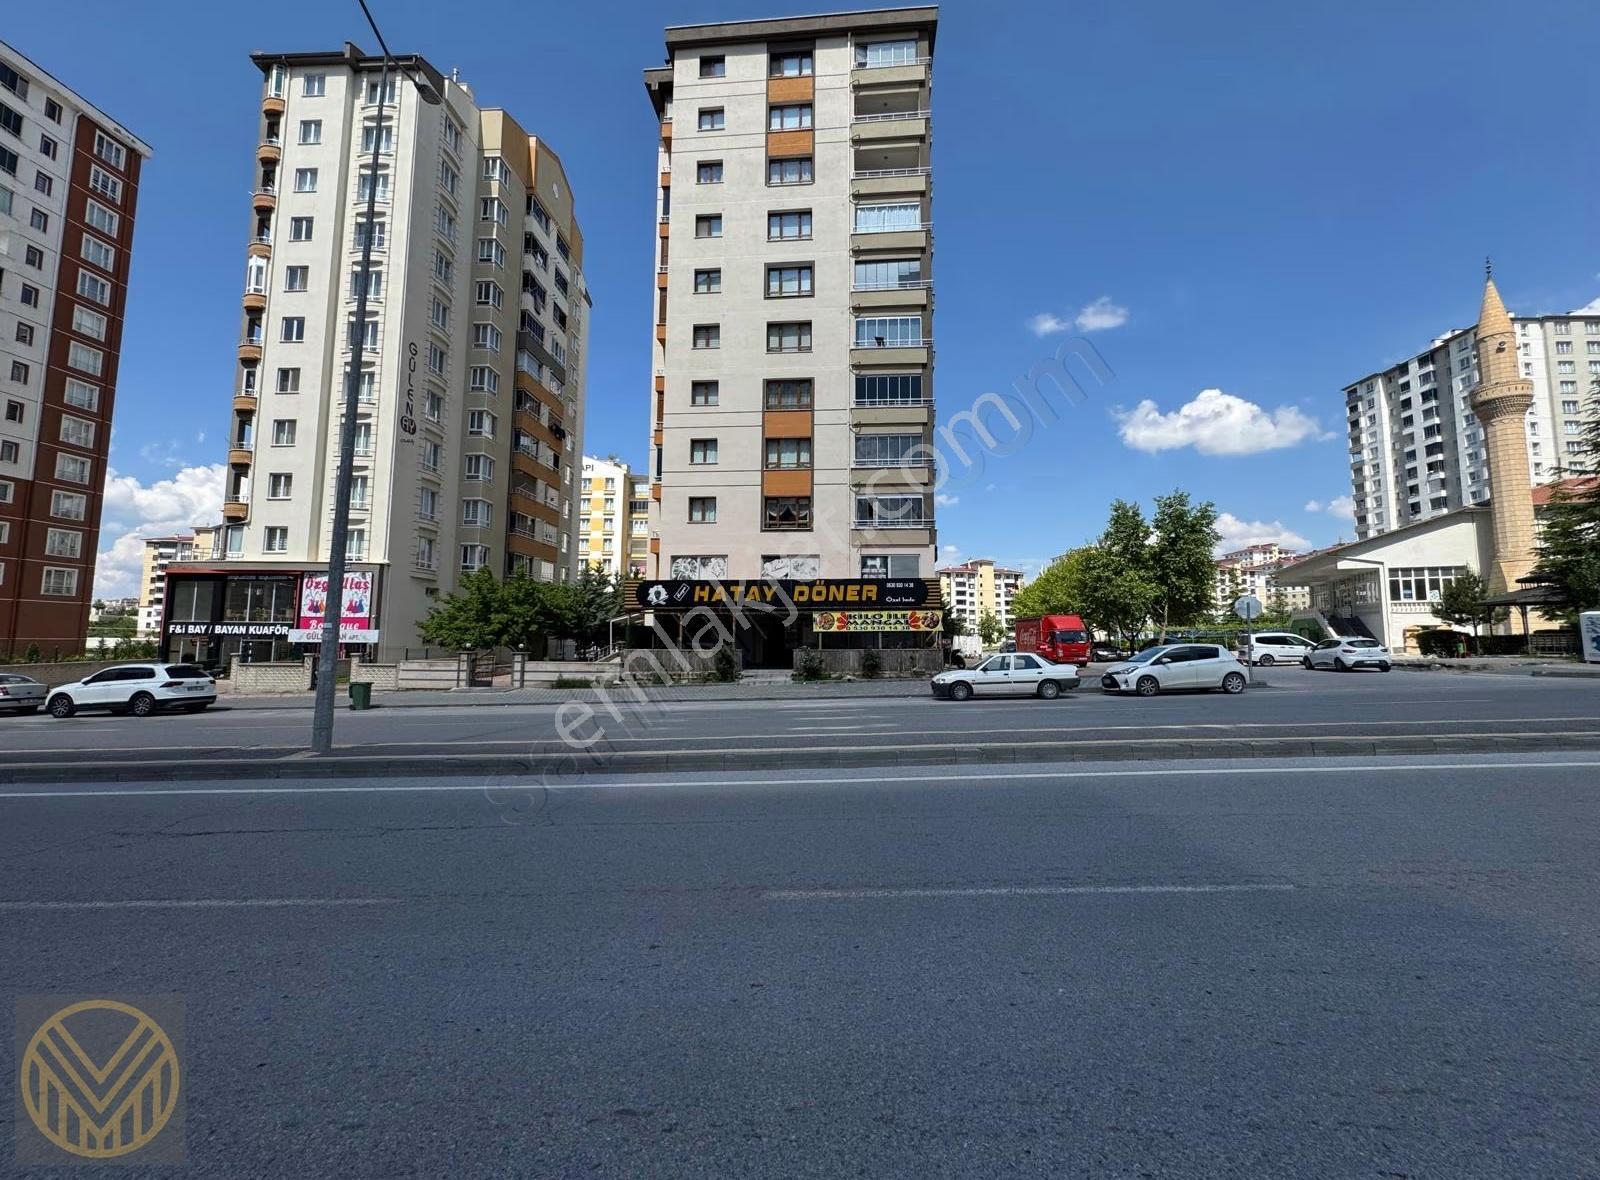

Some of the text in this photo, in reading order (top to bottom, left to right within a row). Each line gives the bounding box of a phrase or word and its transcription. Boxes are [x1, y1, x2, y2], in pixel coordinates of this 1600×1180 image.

[305, 574, 328, 592] Özg
[694, 579, 878, 602] HATAY DÖNER
[188, 625, 208, 634] BAY
[215, 625, 246, 635] BAYAN
[249, 625, 289, 635] KUAFÖR
[309, 619, 360, 631] Boque
